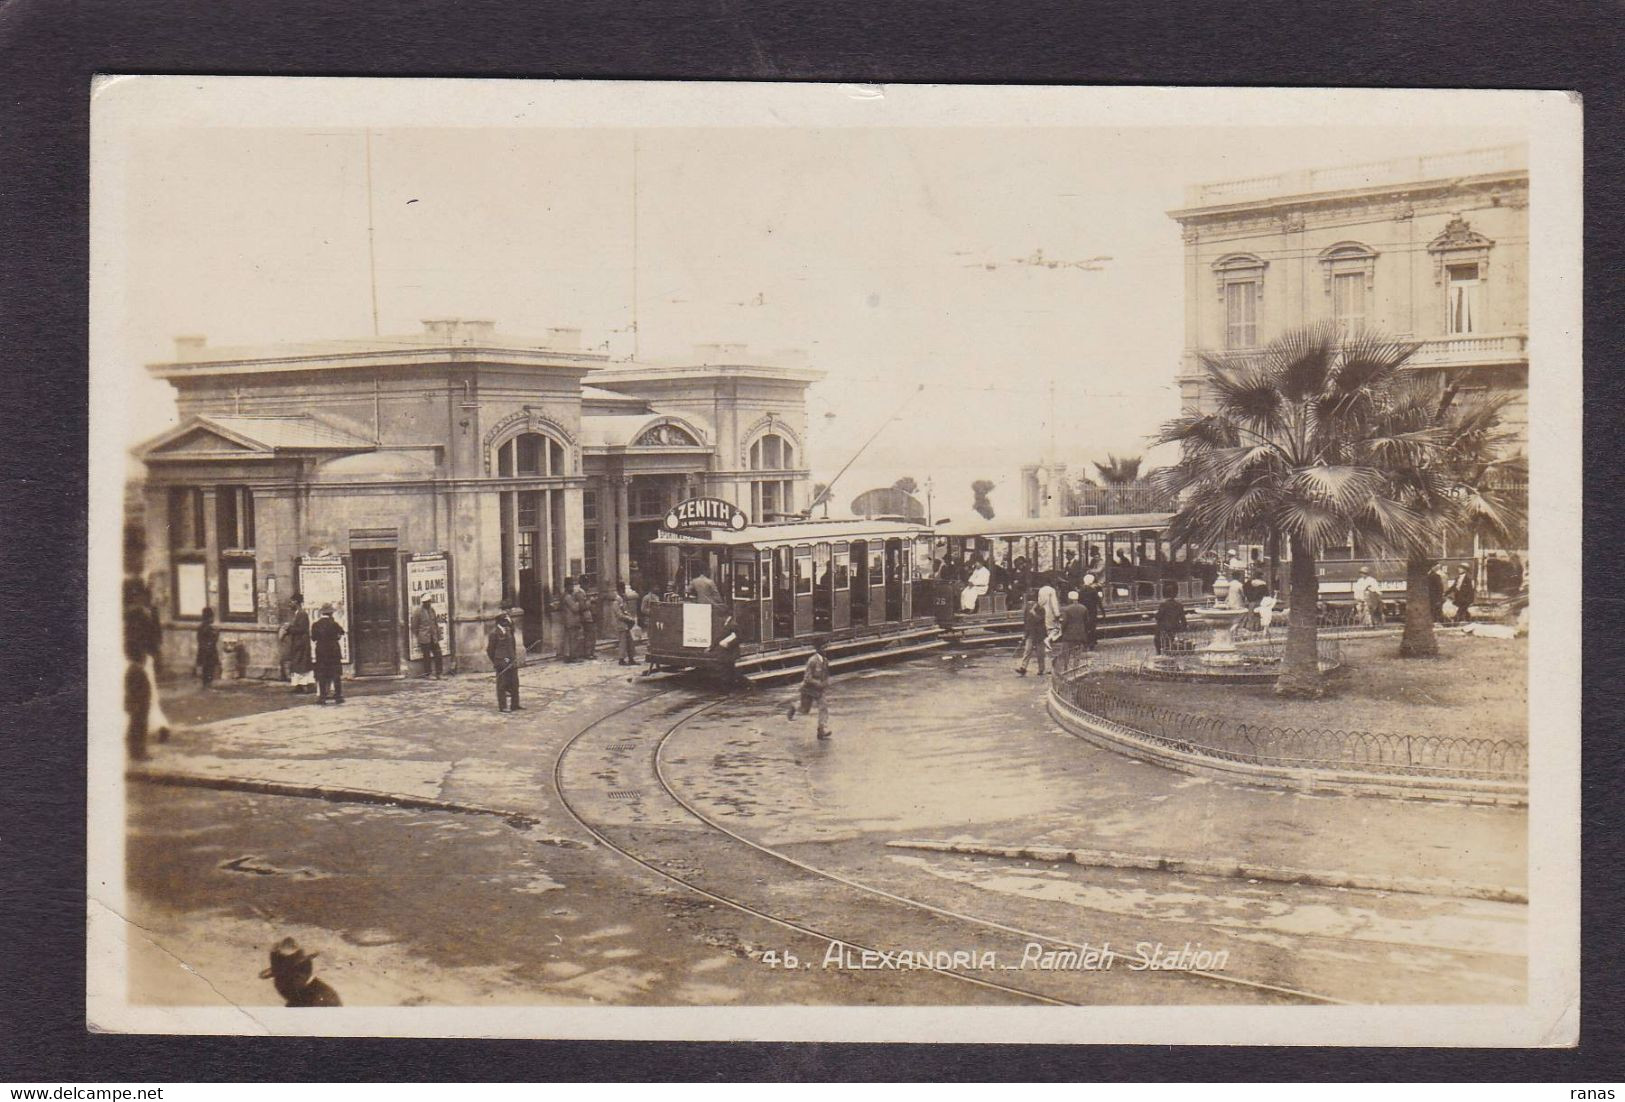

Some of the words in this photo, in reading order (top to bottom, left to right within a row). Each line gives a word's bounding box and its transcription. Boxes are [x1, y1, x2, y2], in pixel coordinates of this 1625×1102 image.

[678, 500, 730, 520] ZENITH
[412, 580, 422, 592] LA
[425, 578, 445, 590] DAME
